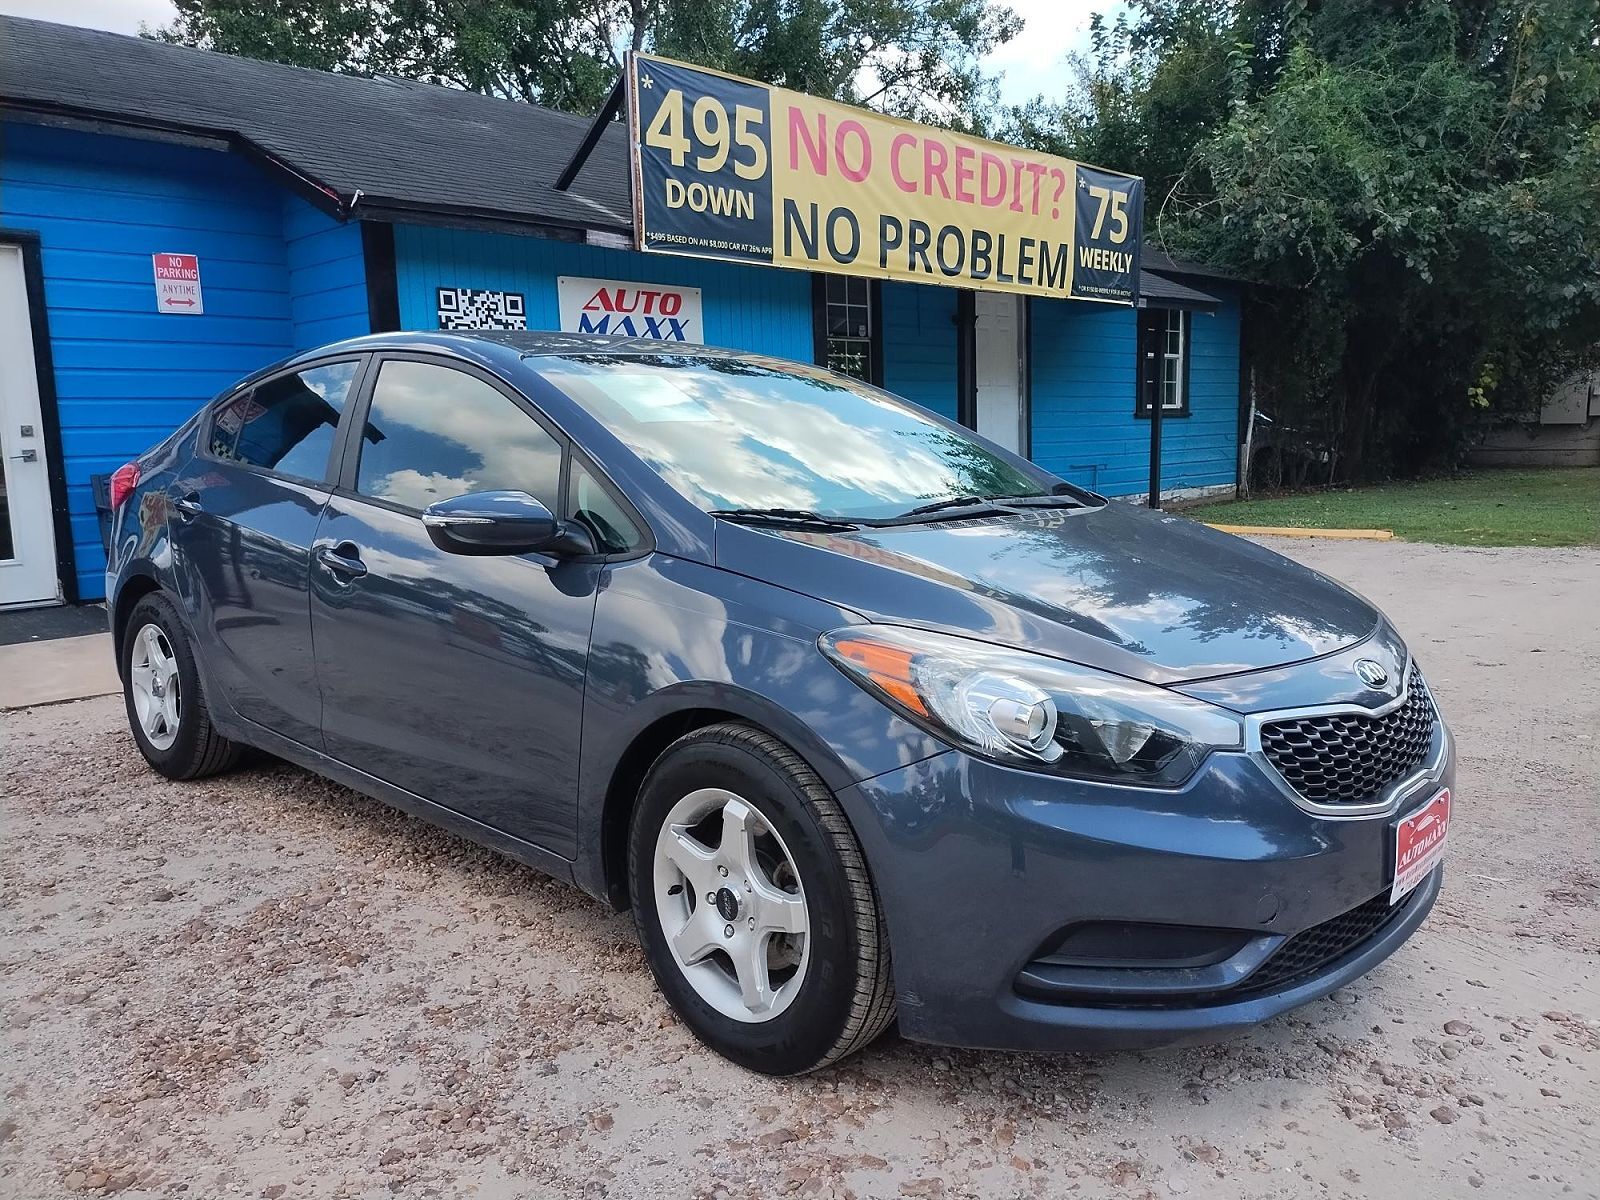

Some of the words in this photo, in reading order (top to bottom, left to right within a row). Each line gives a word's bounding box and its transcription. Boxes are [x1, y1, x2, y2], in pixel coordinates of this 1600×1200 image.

[788, 105, 872, 184] NO
[890, 132, 1067, 220] CREDIT?
[665, 178, 755, 220] DOWN
[667, 233, 687, 244] BASED
[688, 236, 698, 246] ON
[699, 238, 708, 248] AN
[729, 242, 741, 252] CAR
[741, 243, 748, 252] AT
[783, 197, 861, 265] NO
[879, 214, 1069, 290] PROBLEM
[158, 267, 197, 279] PARKING
[169, 257, 182, 267] NO
[1079, 245, 1133, 274] WEEKLY
[163, 284, 195, 295] ANYTIME
[582, 287, 682, 316] AUTO
[578, 313, 690, 341] MAXX
